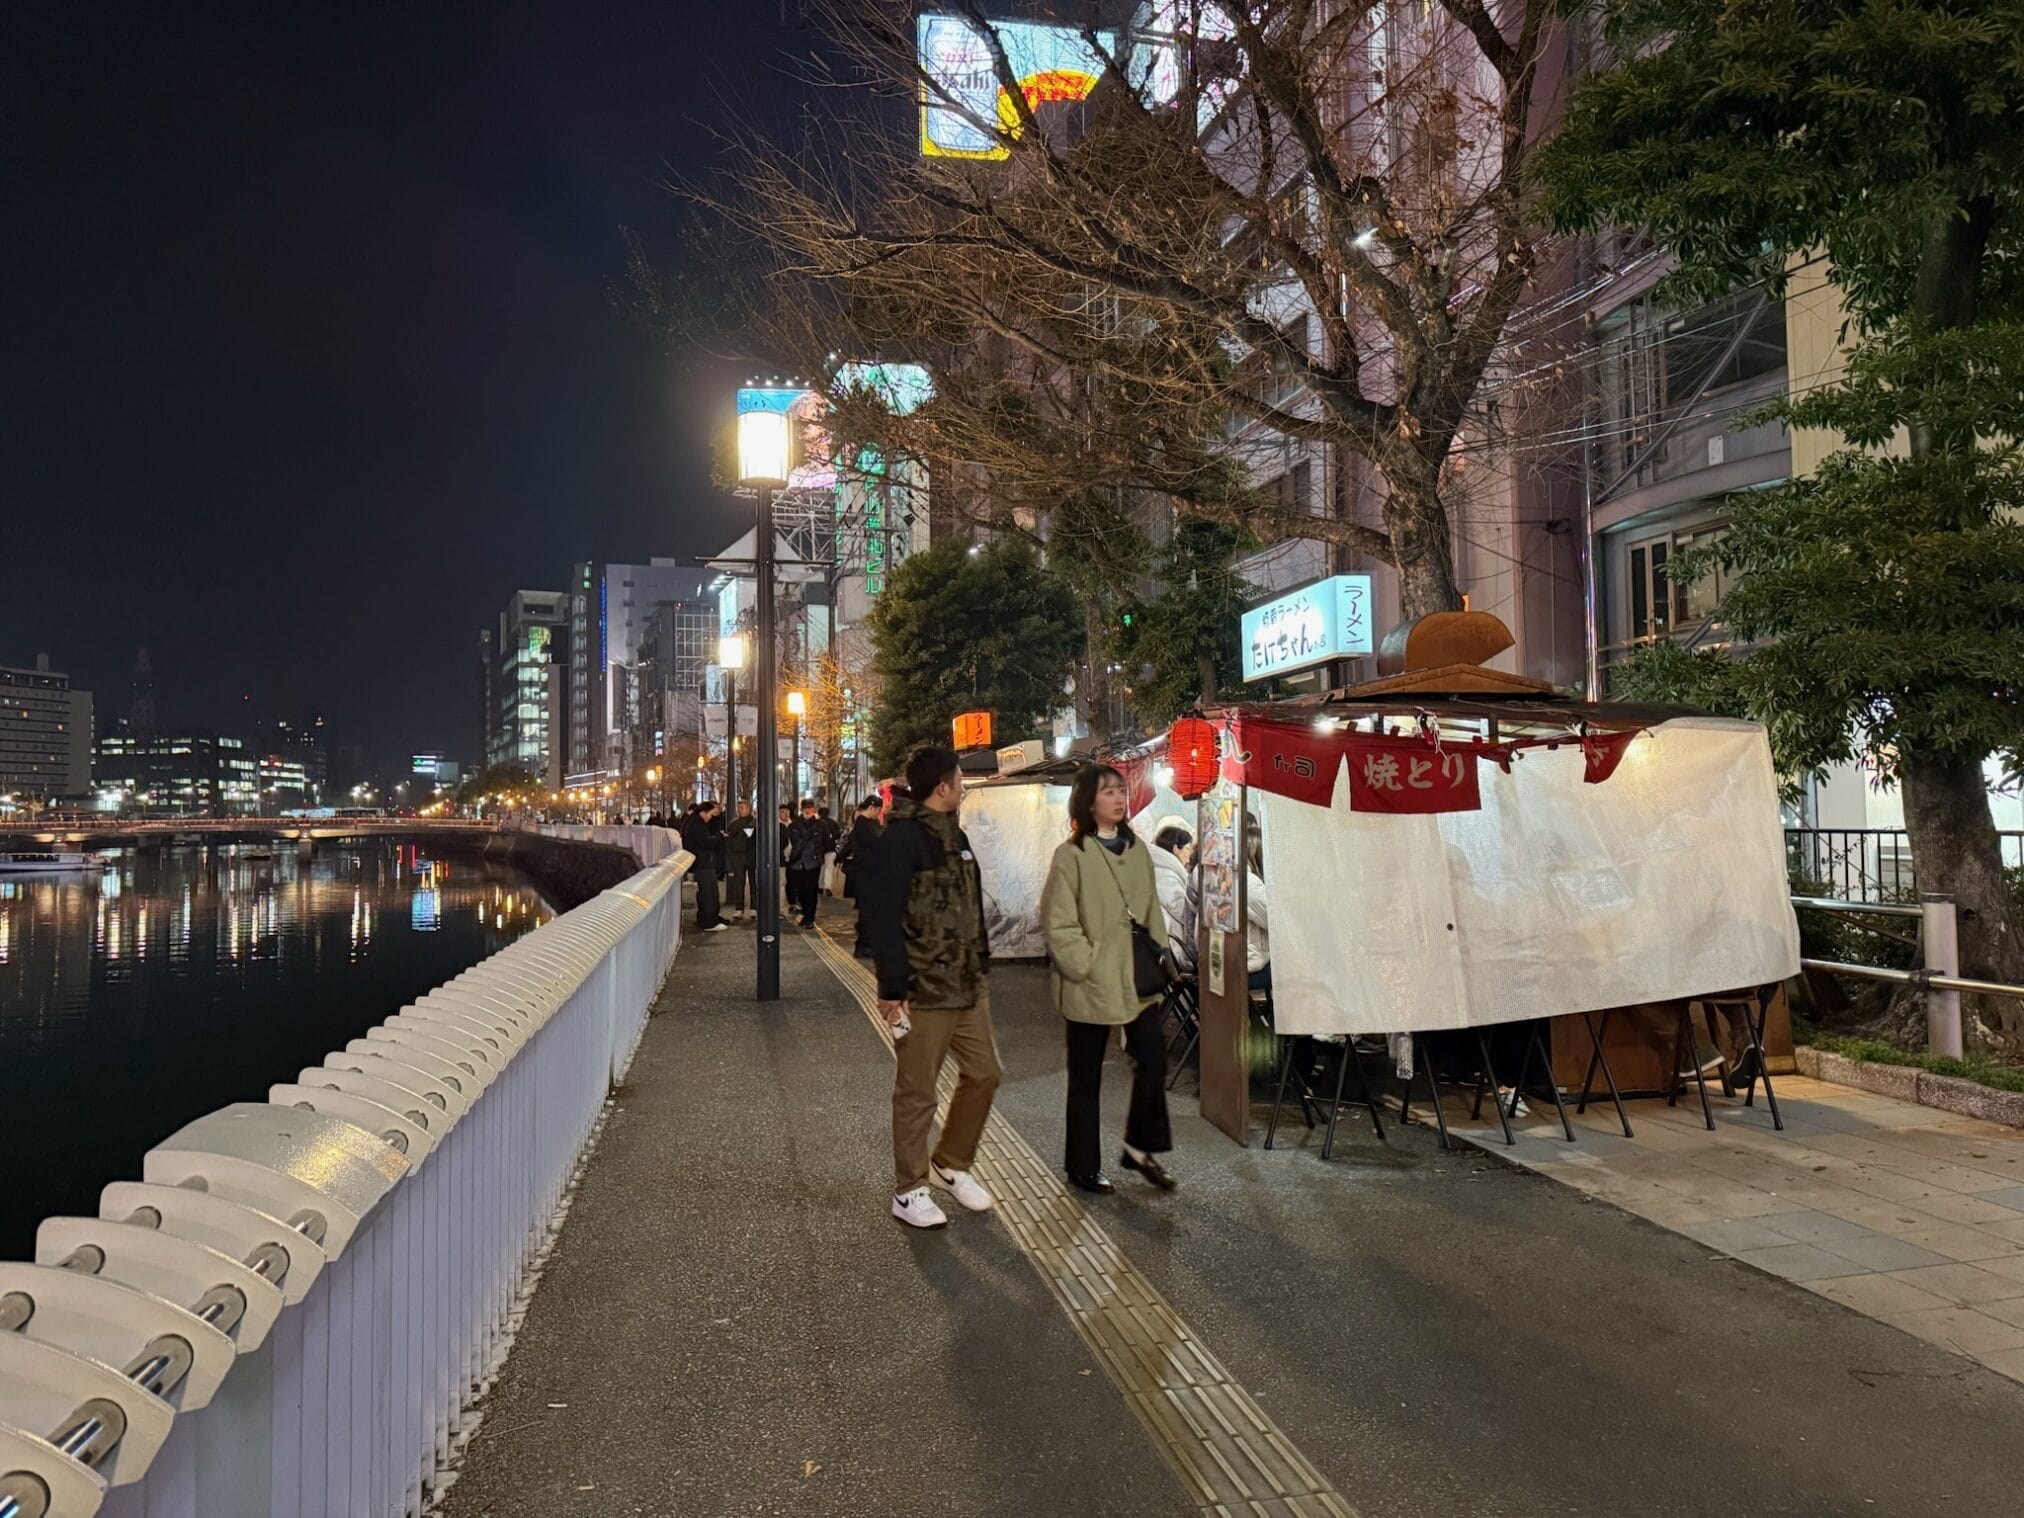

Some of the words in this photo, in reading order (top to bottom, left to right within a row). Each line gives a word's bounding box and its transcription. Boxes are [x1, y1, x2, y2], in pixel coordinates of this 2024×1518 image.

[1344, 585, 1365, 645] ラーメン
[1363, 753, 1466, 792] 焼とり
